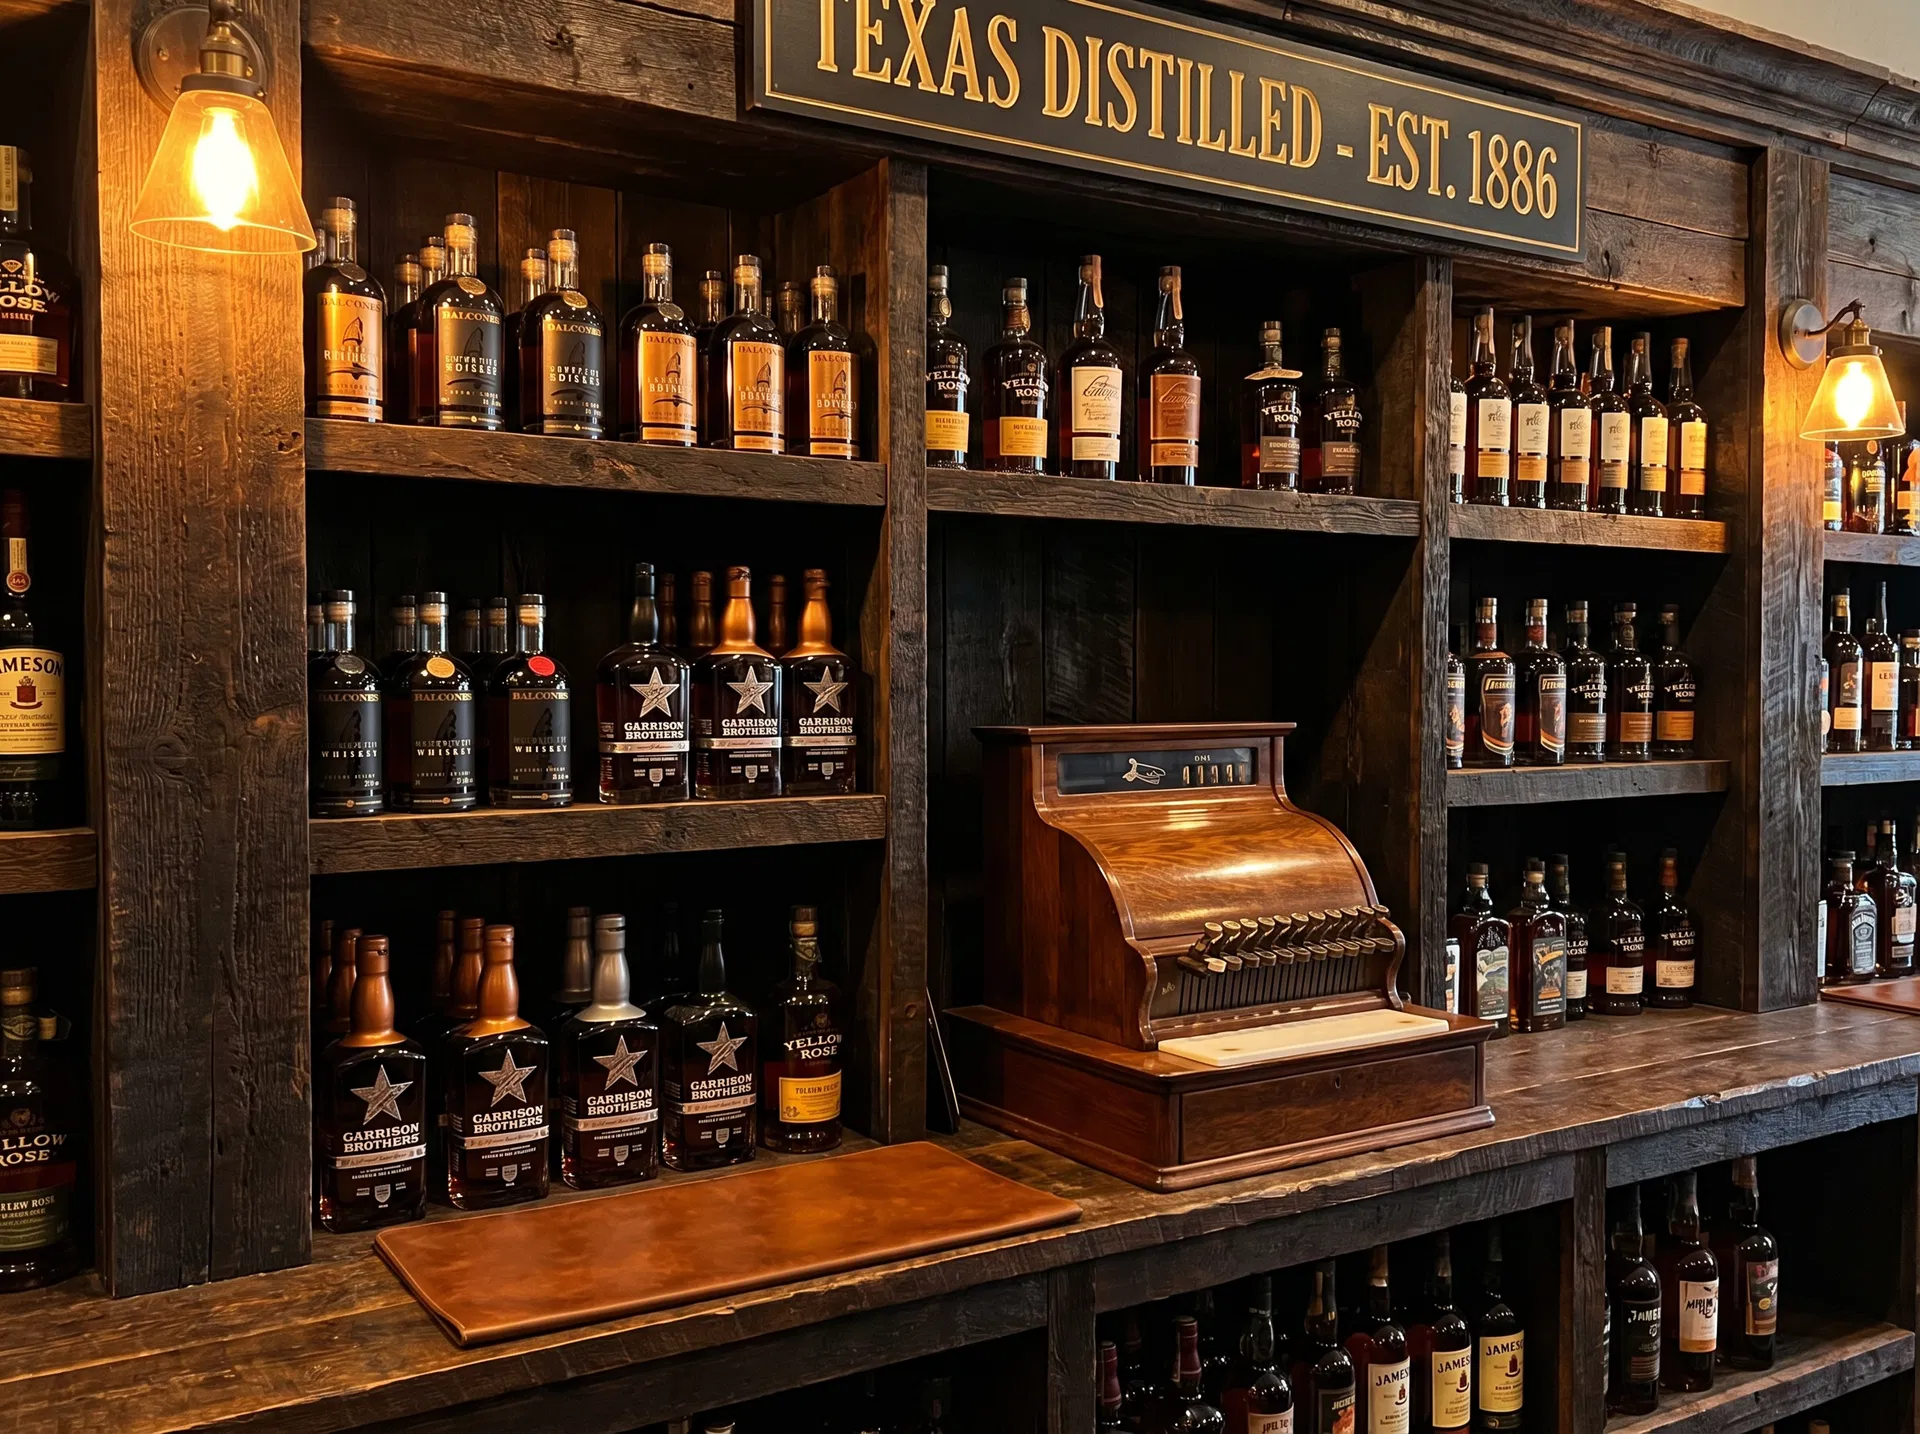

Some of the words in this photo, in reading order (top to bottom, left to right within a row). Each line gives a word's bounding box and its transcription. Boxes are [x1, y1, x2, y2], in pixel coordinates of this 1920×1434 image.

[817, 0, 1020, 109] TEXAS
[1041, 25, 1323, 169] DISTILLED
[1366, 102, 1456, 200] EST.
[1468, 129, 1558, 220] 1886
[0, 656, 63, 677] MESON
[512, 692, 569, 701] BALCONES
[624, 721, 684, 732] GARRISON
[721, 718, 778, 728] GARRISON
[798, 717, 854, 727] GARRISON
[799, 725, 853, 734] BROTHERS
[625, 730, 684, 740] BROTHERS
[722, 726, 778, 736] BROTHERS
[801, 1045, 837, 1060] ROSE
[690, 1073, 752, 1091] GARRISON
[586, 1088, 653, 1106] GARRISON
[691, 1083, 752, 1100] BROTHERS
[472, 1105, 544, 1124] GARRISON
[587, 1098, 653, 1116] BROTHERS
[343, 1122, 420, 1142] GARRISON
[473, 1115, 543, 1134] BROTHERS
[343, 1133, 420, 1153] BROTHERS
